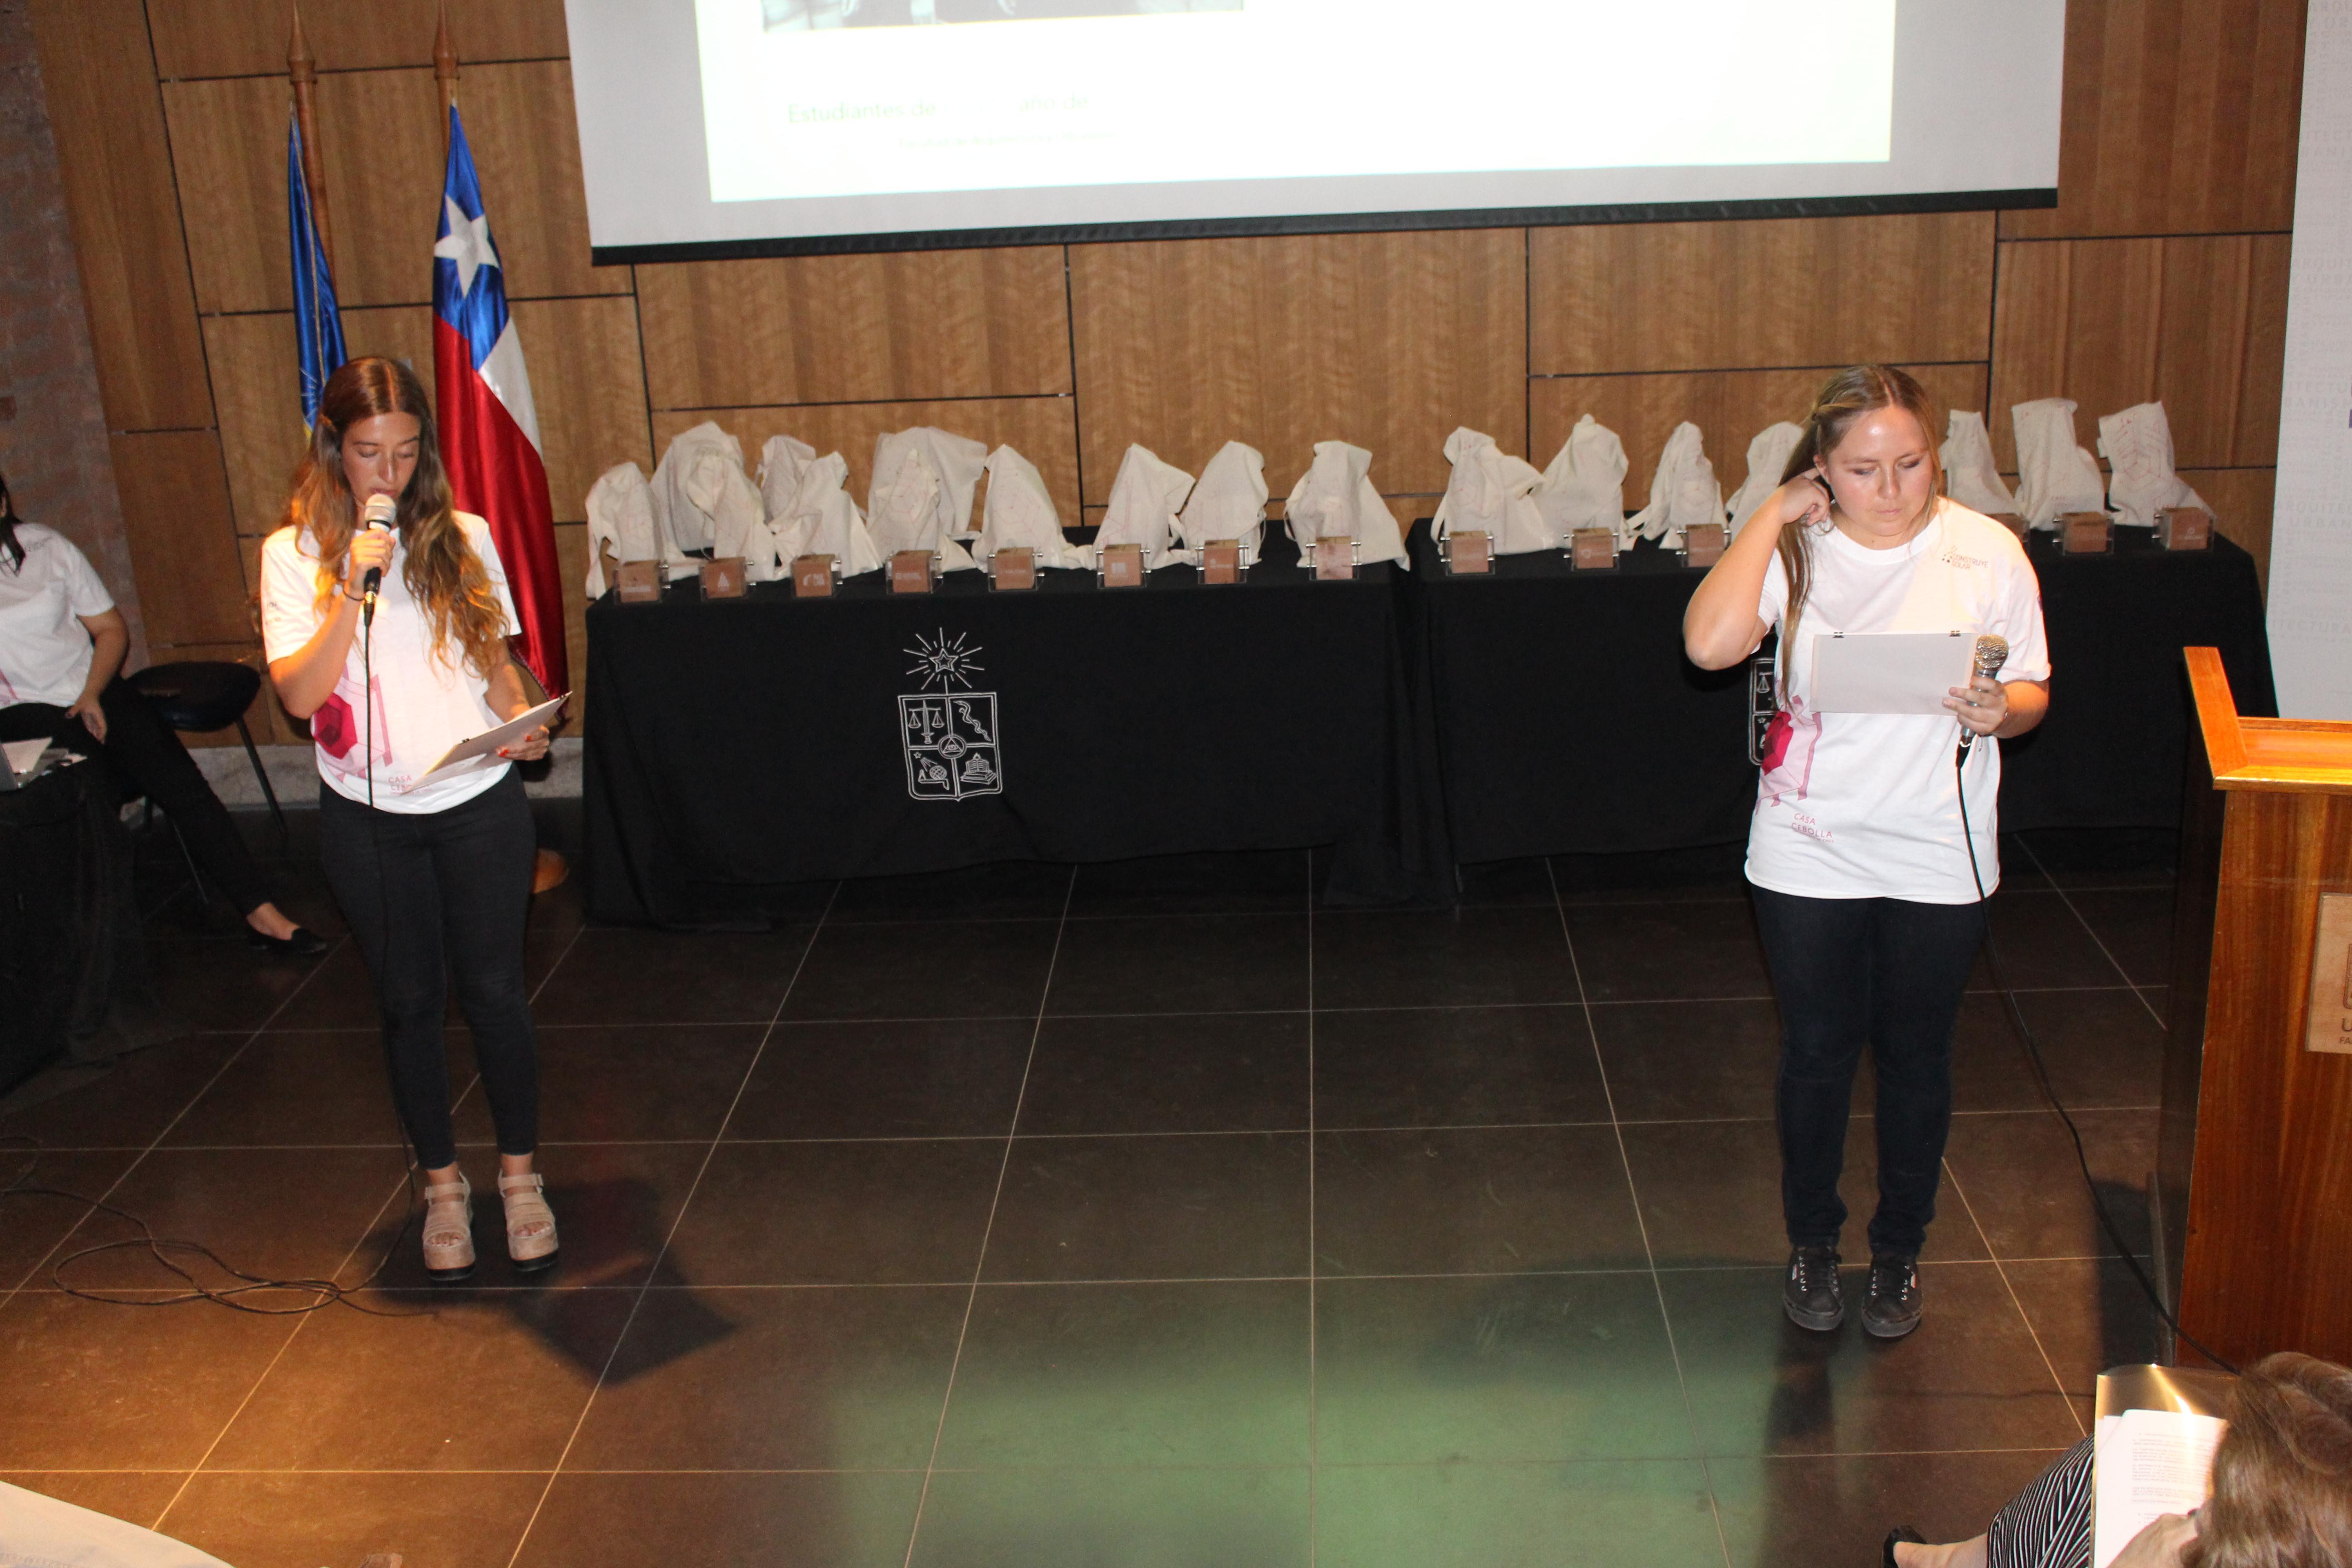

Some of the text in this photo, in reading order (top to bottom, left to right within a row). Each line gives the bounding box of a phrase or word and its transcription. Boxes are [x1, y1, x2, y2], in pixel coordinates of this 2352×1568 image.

[788, 101, 904, 123] Estudiantes
[911, 97, 936, 117] de
[1019, 94, 1056, 113] año
[1063, 92, 1088, 110] de
[1952, 554, 1989, 568] CONSTRUYE
[388, 774, 412, 784] CASA
[1793, 813, 1815, 825] CASA
[1791, 823, 1833, 838] CEBOLLA
